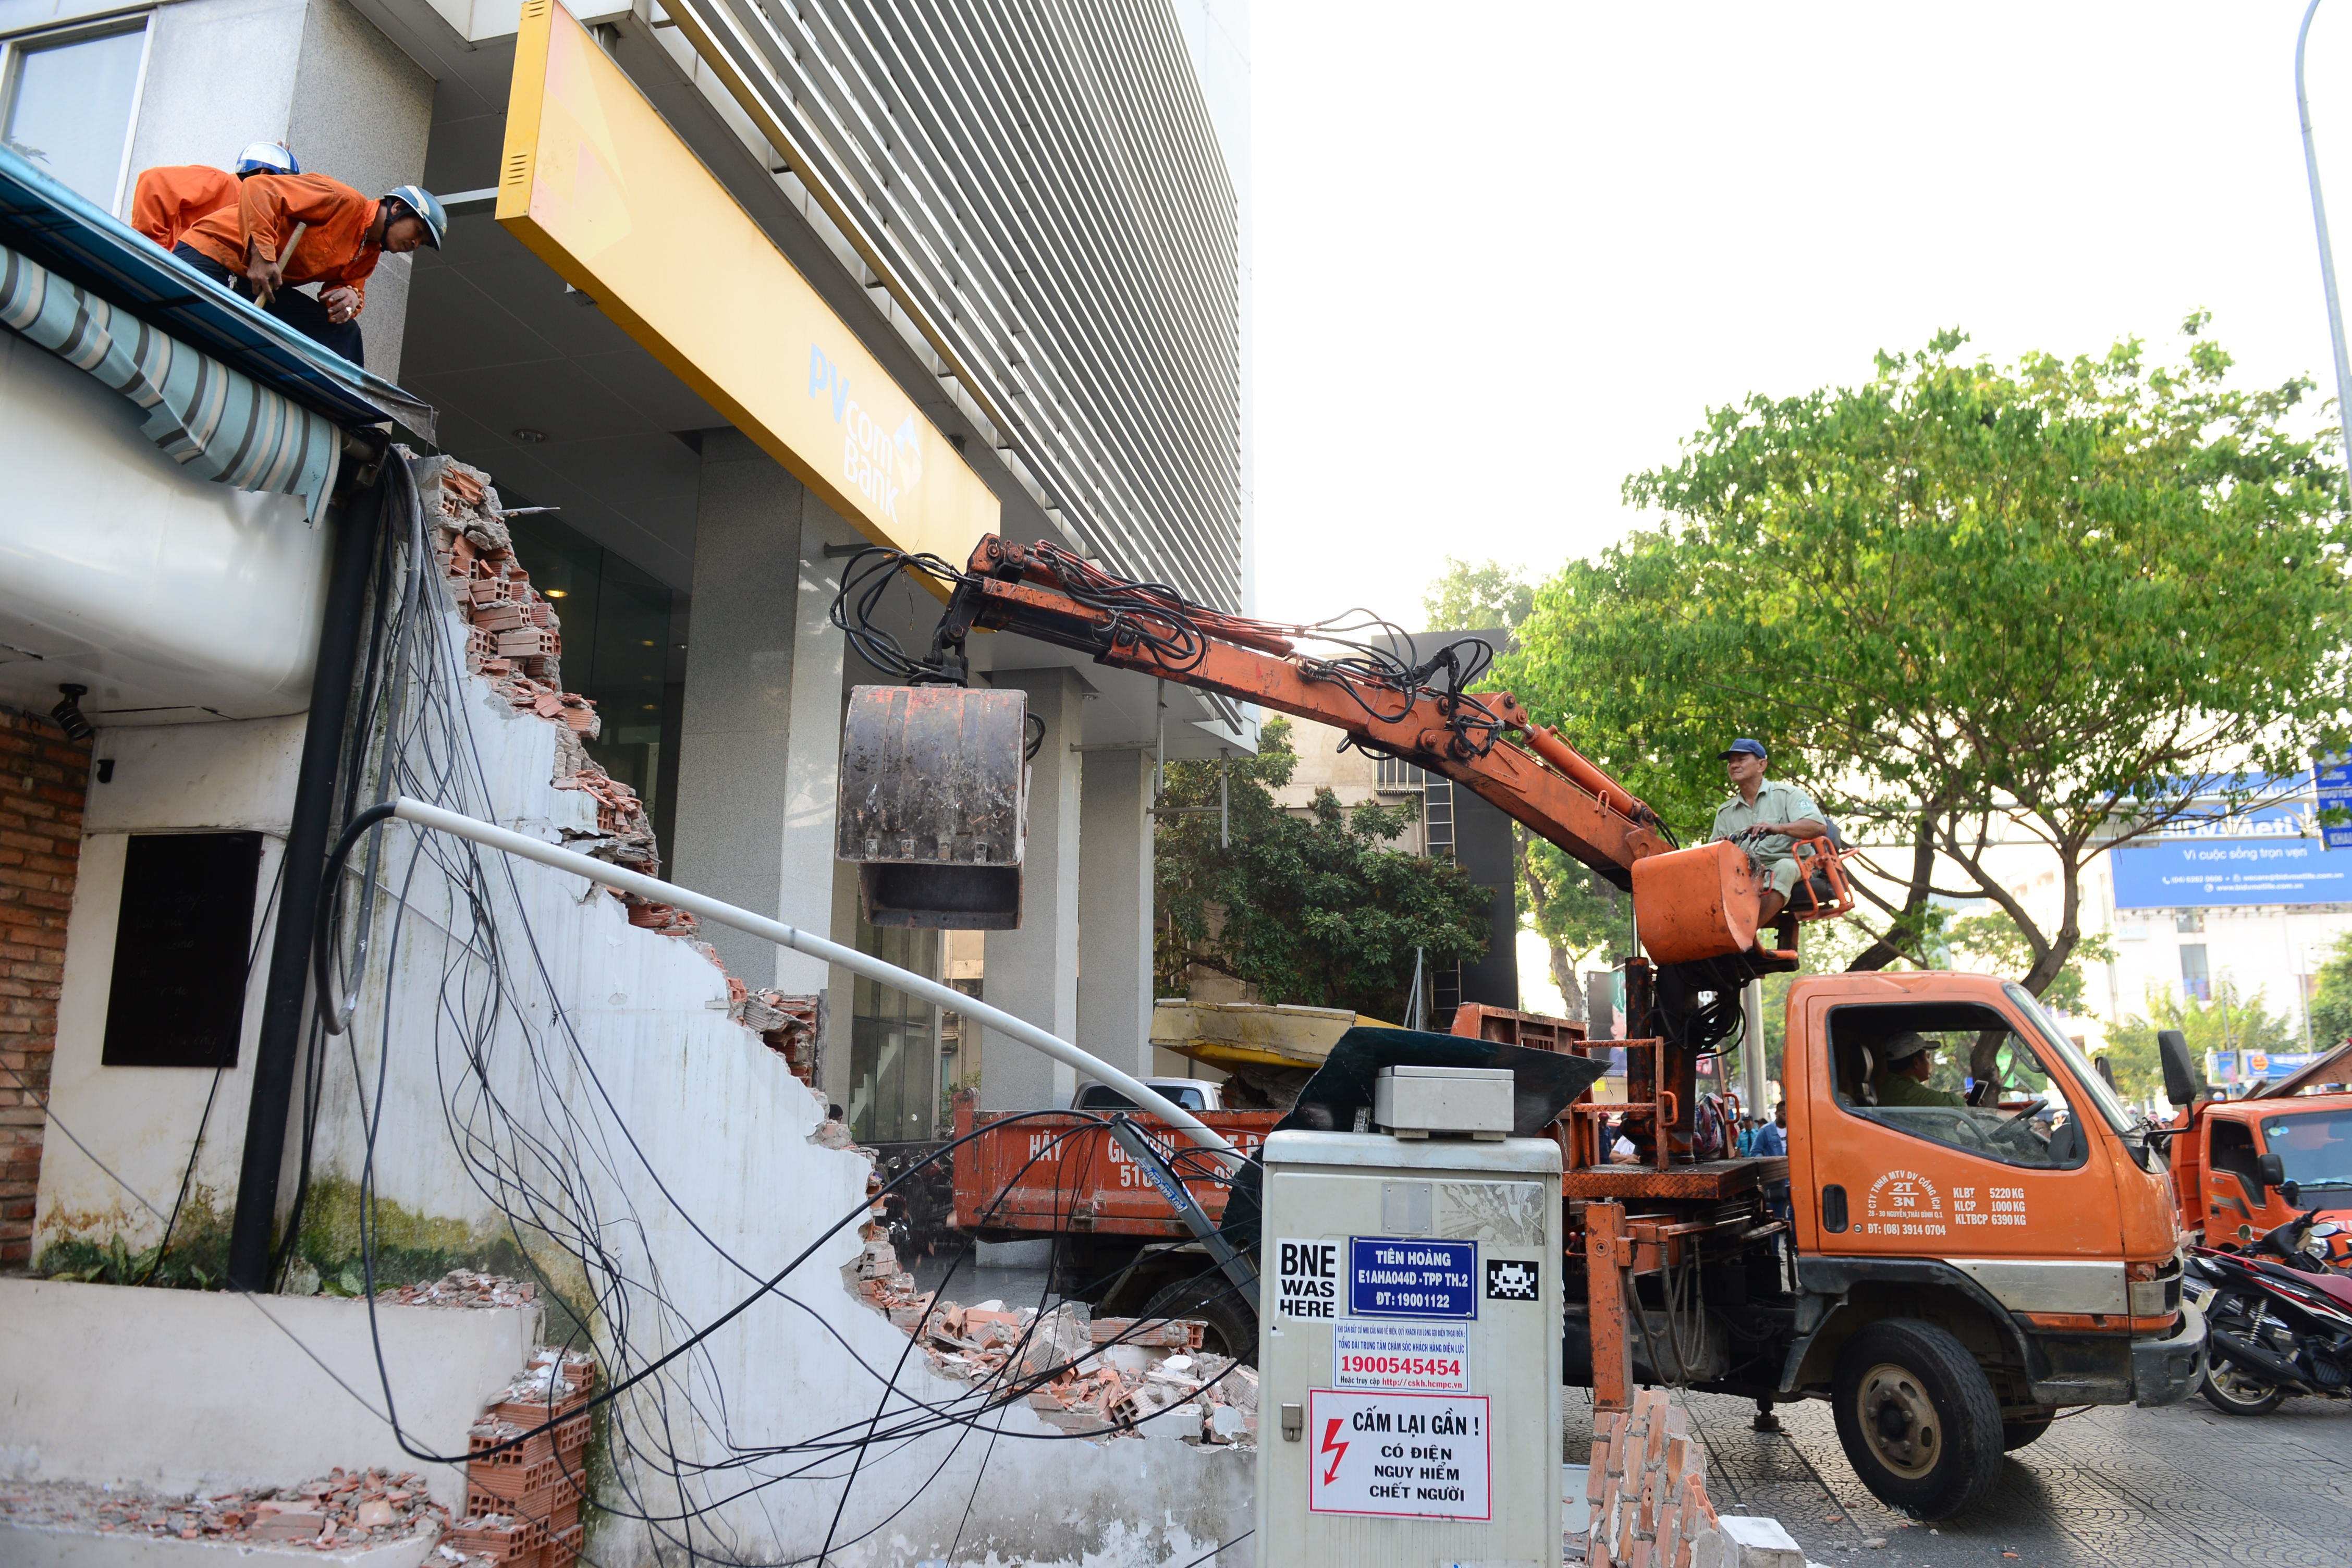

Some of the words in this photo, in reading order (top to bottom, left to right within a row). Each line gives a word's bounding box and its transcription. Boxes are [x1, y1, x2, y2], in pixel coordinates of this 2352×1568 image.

[843, 436, 899, 524] Bank
[2183, 849, 2196, 860] Vì
[2199, 849, 2226, 861] cuộc
[2228, 846, 2257, 861] sống
[2260, 847, 2283, 859] trọn
[2285, 848, 2307, 859] vẹn
[1029, 1130, 1063, 1161] HÃY
[1871, 1175, 1889, 1193] TNHH
[1888, 1170, 1905, 1180] MTV
[1907, 1171, 1918, 1181] DV
[1893, 1182, 1914, 1192] 2T
[1918, 1177, 1937, 1196] CÔNG
[1953, 1187, 1975, 1198] KLBT
[1989, 1188, 2011, 1198] 5220
[2012, 1188, 2025, 1198] KG
[1868, 1194, 1877, 1208] CTY
[1893, 1196, 1915, 1207] 3N
[1931, 1196, 1941, 1209] ÍCH
[1954, 1200, 1976, 1211] KLCP
[1991, 1201, 2012, 1211] 1000
[2013, 1201, 2026, 1212] KG
[1868, 1223, 1881, 1234] ĐT:
[1884, 1223, 1900, 1235] (08)
[1902, 1224, 1922, 1235] 3914
[1925, 1224, 1946, 1235] 0704
[1955, 1214, 1988, 1224] KLTBCP
[1991, 1214, 2013, 1225] 6390
[2014, 1215, 2027, 1226] KG
[1281, 1243, 1336, 1278] BNE
[1376, 1246, 1404, 1265] TIÊN
[1408, 1248, 1451, 1266] HOÀNG
[1358, 1269, 1416, 1285] E1AHA044D
[1445, 1273, 1468, 1287] TH.2
[1281, 1279, 1335, 1297] WAS
[1280, 1299, 1334, 1318] HERE
[1376, 1292, 1395, 1306] ĐT:
[1398, 1293, 1450, 1308] 19001122
[1339, 1336, 1350, 1349] TỔNG
[1361, 1341, 1376, 1350] TRUNG
[1377, 1340, 1387, 1350] TÂM
[1402, 1340, 1411, 1351] SÓC
[1413, 1341, 1428, 1352] KHÁCH
[1429, 1341, 1442, 1352] HÀNG
[1443, 1342, 1454, 1355] ĐIỆN
[1455, 1343, 1464, 1355] LỰC
[1341, 1355, 1461, 1376] 1900545454
[1340, 1376, 1355, 1386] Hoặc
[1356, 1376, 1368, 1385] truy
[1369, 1378, 1380, 1387] cập
[1353, 1405, 1391, 1432] CẤM
[1398, 1414, 1425, 1438] LẠI
[1431, 1407, 1466, 1436] GẦN
[1381, 1443, 1404, 1458] CÓ
[1411, 1444, 1452, 1462] ĐIỆN
[1374, 1465, 1414, 1479] NGUY
[1420, 1462, 1460, 1480] HIỂM
[1369, 1482, 1411, 1499] CHẾT
[1417, 1486, 1464, 1501] NGƯỜI
